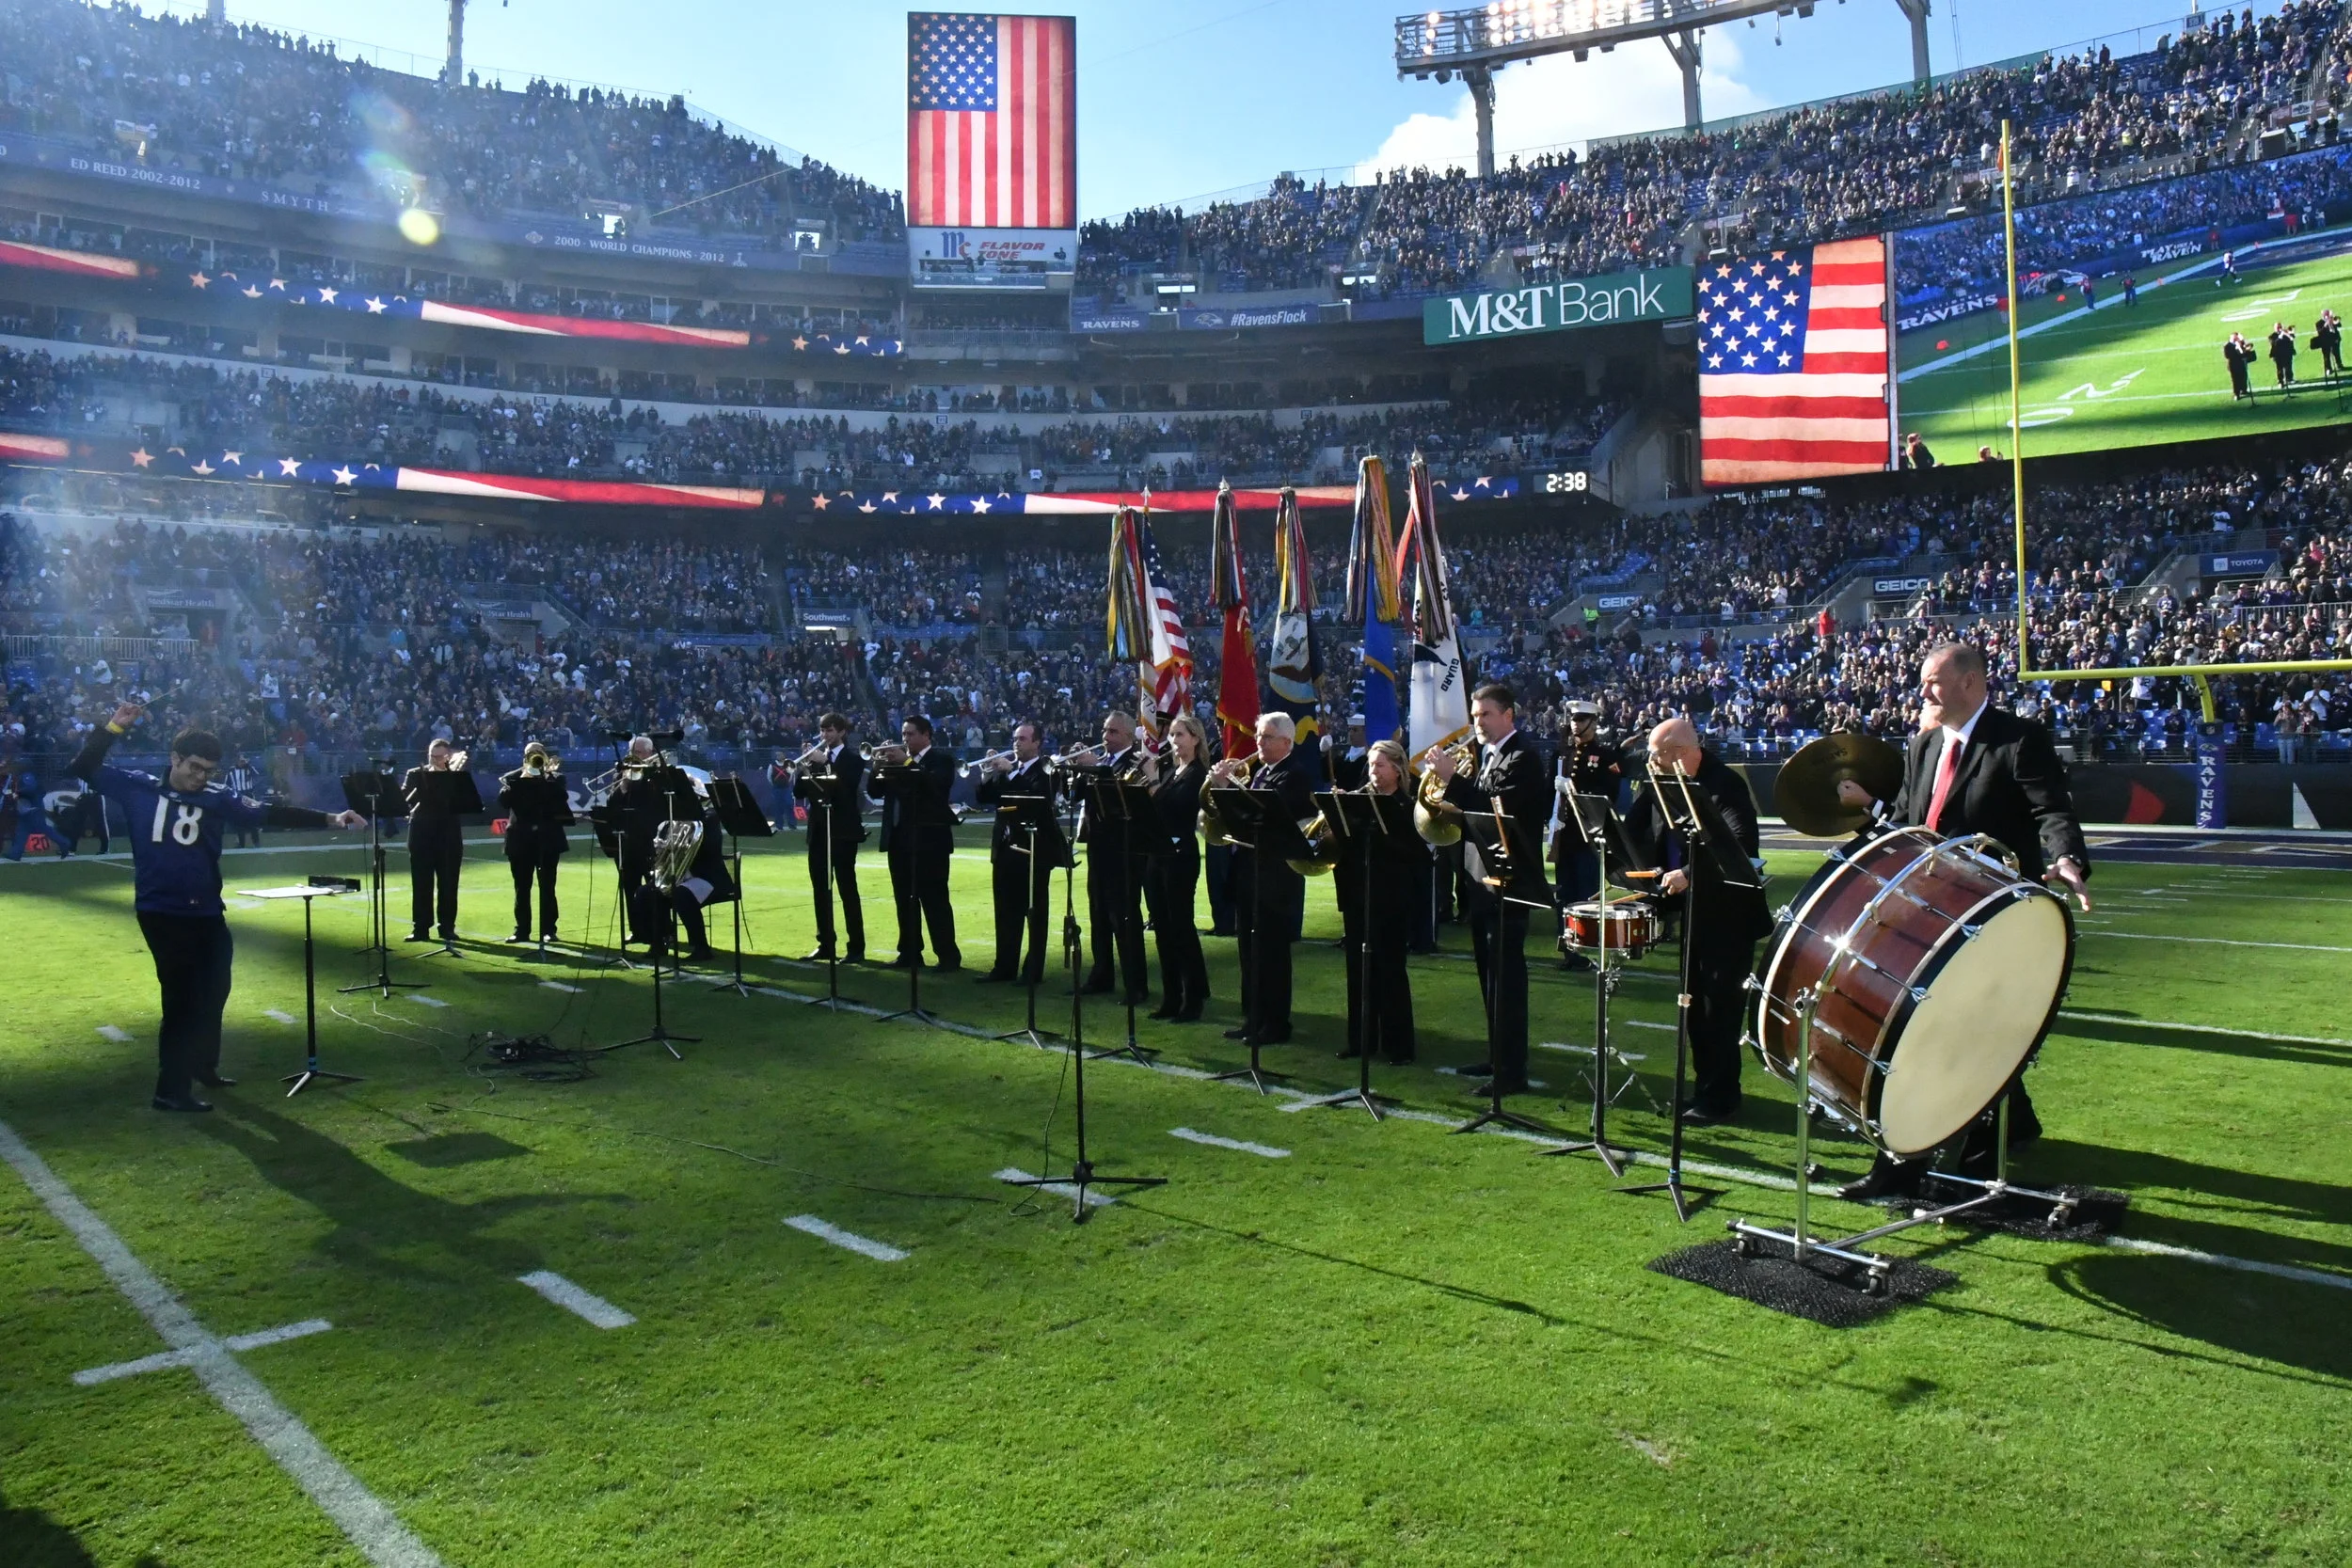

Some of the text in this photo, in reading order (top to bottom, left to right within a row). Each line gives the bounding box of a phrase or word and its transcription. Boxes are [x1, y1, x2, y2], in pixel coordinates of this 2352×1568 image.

[71, 158, 201, 190] ED REED 2002-2012
[554, 235, 724, 262] 2000 WORLD CHAMPIONS 2012
[978, 250, 1022, 260] TONE
[979, 241, 1045, 251] FLAVOR
[1231, 309, 1307, 327] #RavensFlock
[1447, 273, 1664, 339] M&T Bank
[1897, 293, 1998, 330] RAVENS
[1081, 320, 1139, 330] RAVENS
[1546, 471, 1586, 493] 2:38
[2231, 559, 2265, 567] TOYOTA
[803, 612, 847, 622] Southwest
[1440, 657, 1459, 692] GUARD
[2200, 756, 2217, 823] RAVENS
[151, 795, 203, 846] 18
